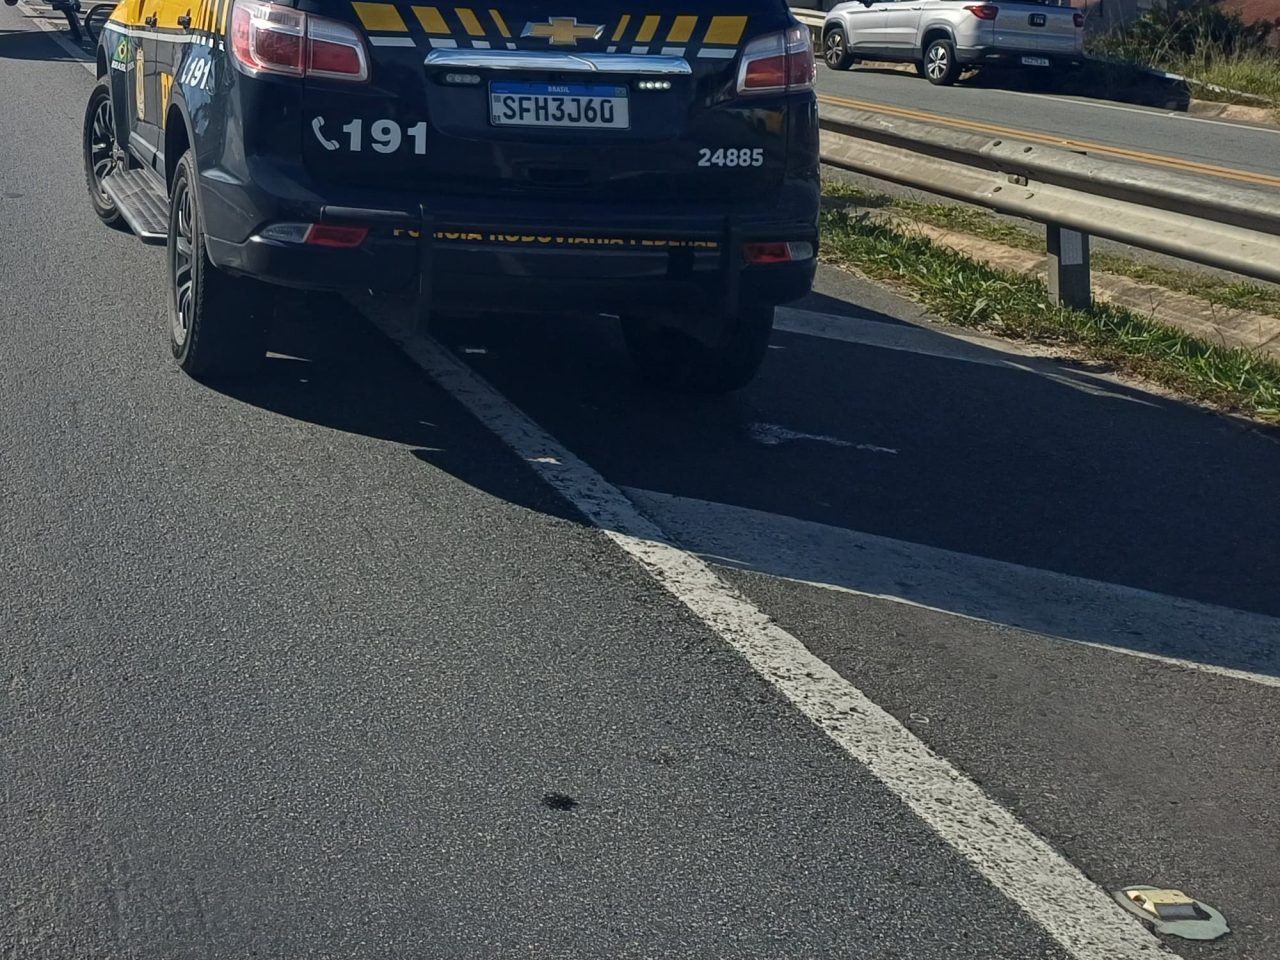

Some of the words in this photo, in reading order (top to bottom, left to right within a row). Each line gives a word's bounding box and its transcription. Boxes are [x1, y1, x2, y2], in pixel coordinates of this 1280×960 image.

[186, 56, 212, 90] 191
[548, 85, 570, 93] BRASIL
[503, 95, 614, 124] SFH3J60
[343, 119, 427, 155] 191
[698, 147, 764, 167] 24885
